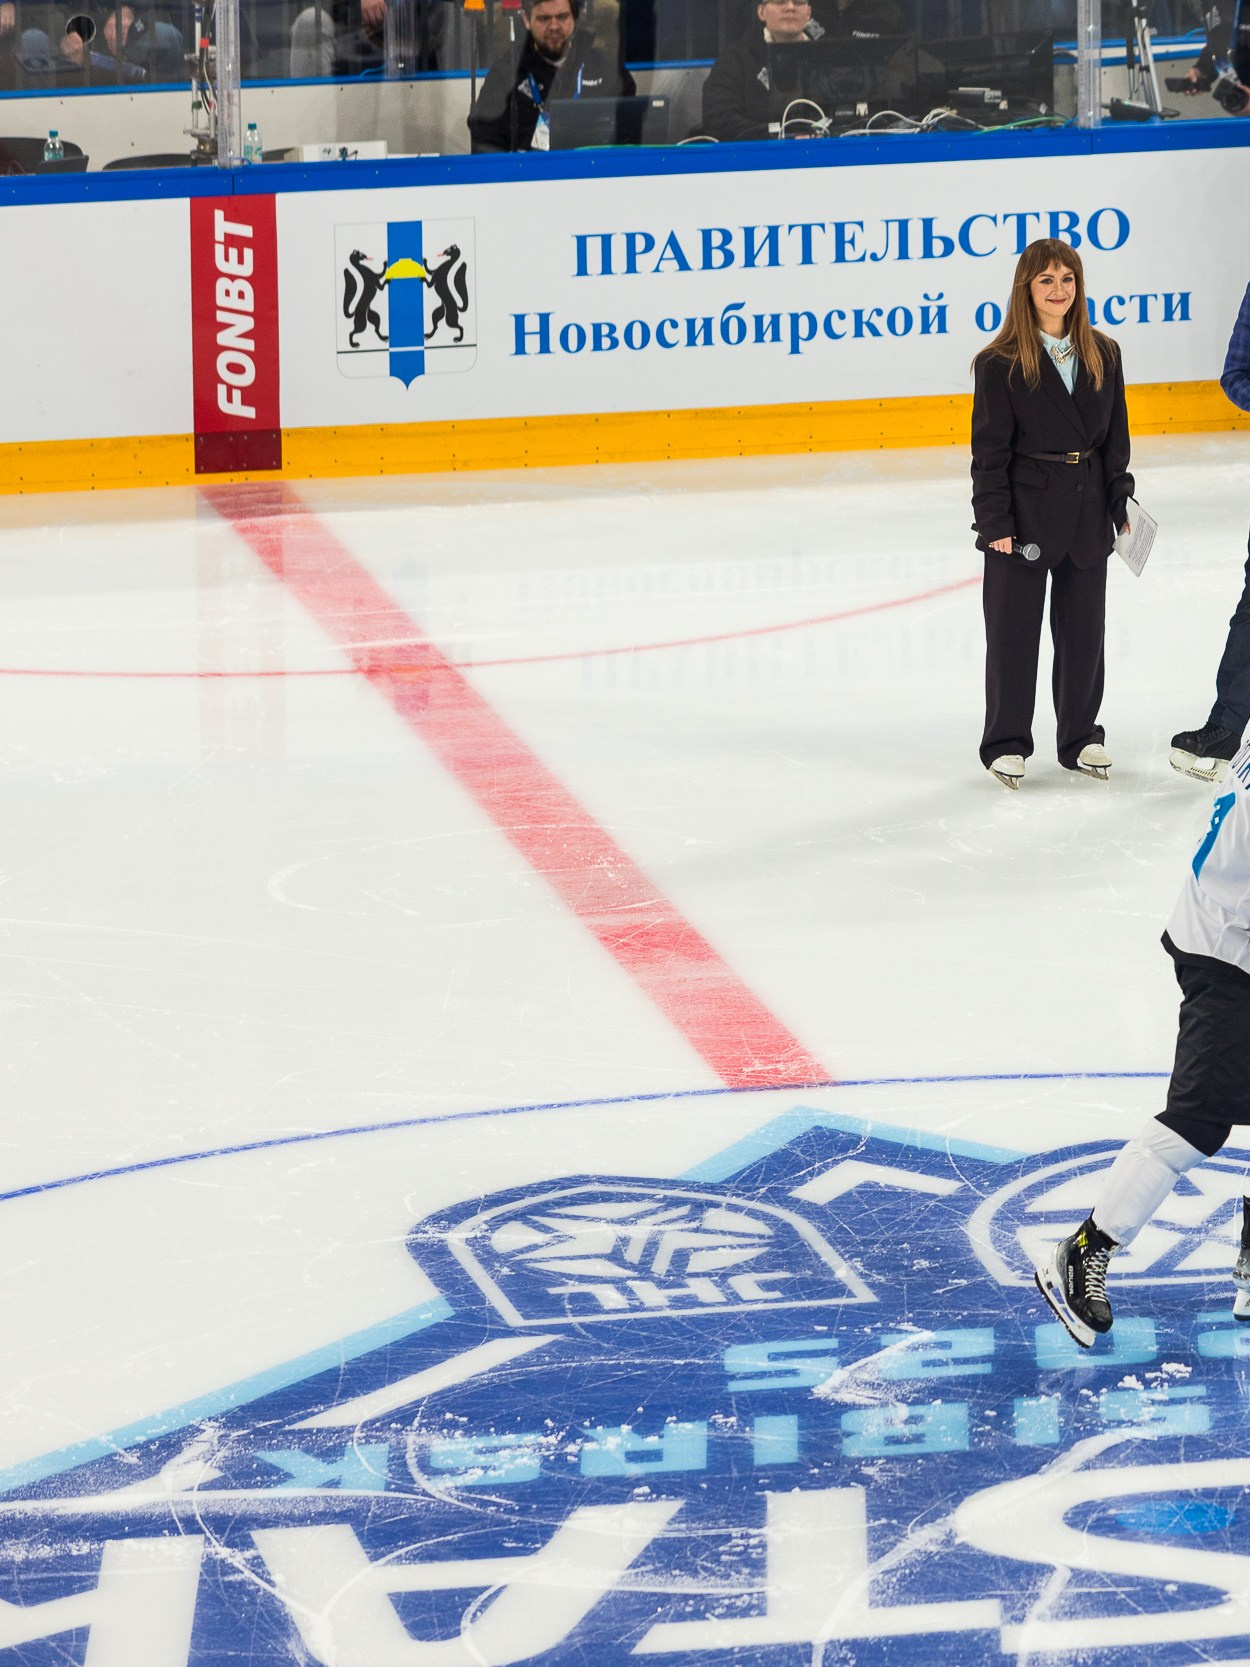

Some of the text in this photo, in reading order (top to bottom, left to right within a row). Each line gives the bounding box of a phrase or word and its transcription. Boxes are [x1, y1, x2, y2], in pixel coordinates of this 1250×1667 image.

[571, 207, 1131, 278] ПРАВИТЕЛЬСТВО
[214, 209, 256, 419] FONBET
[509, 291, 1193, 355] Новосибирской ости
